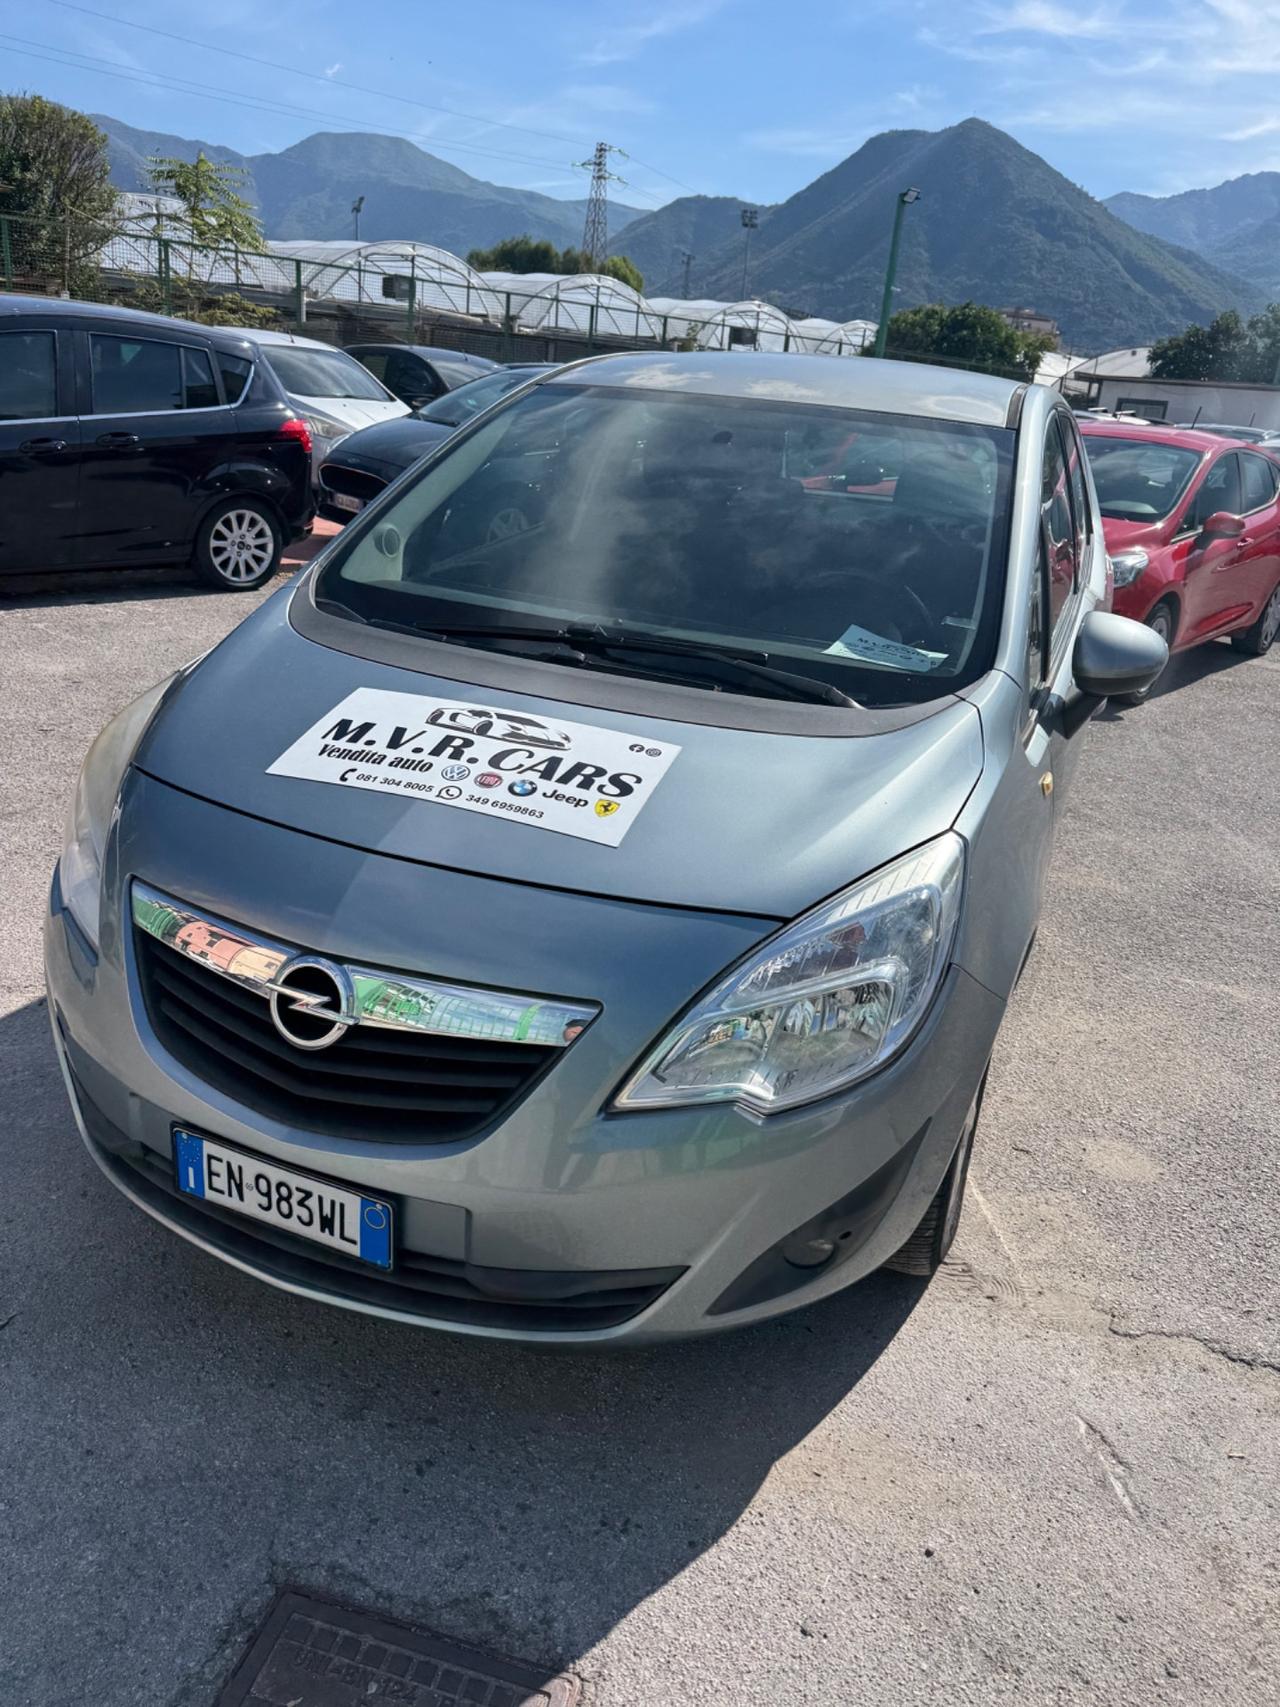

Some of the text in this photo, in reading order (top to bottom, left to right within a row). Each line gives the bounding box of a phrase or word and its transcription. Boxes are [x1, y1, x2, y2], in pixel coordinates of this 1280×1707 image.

[318, 744, 434, 773] Vendita auto
[321, 718, 643, 798] M.V.R. CARS
[355, 773, 435, 793] 081 304 8005
[465, 794, 545, 819] 349 6959863
[542, 788, 589, 808] Jeep
[207, 1153, 358, 1246] EN 983WL
